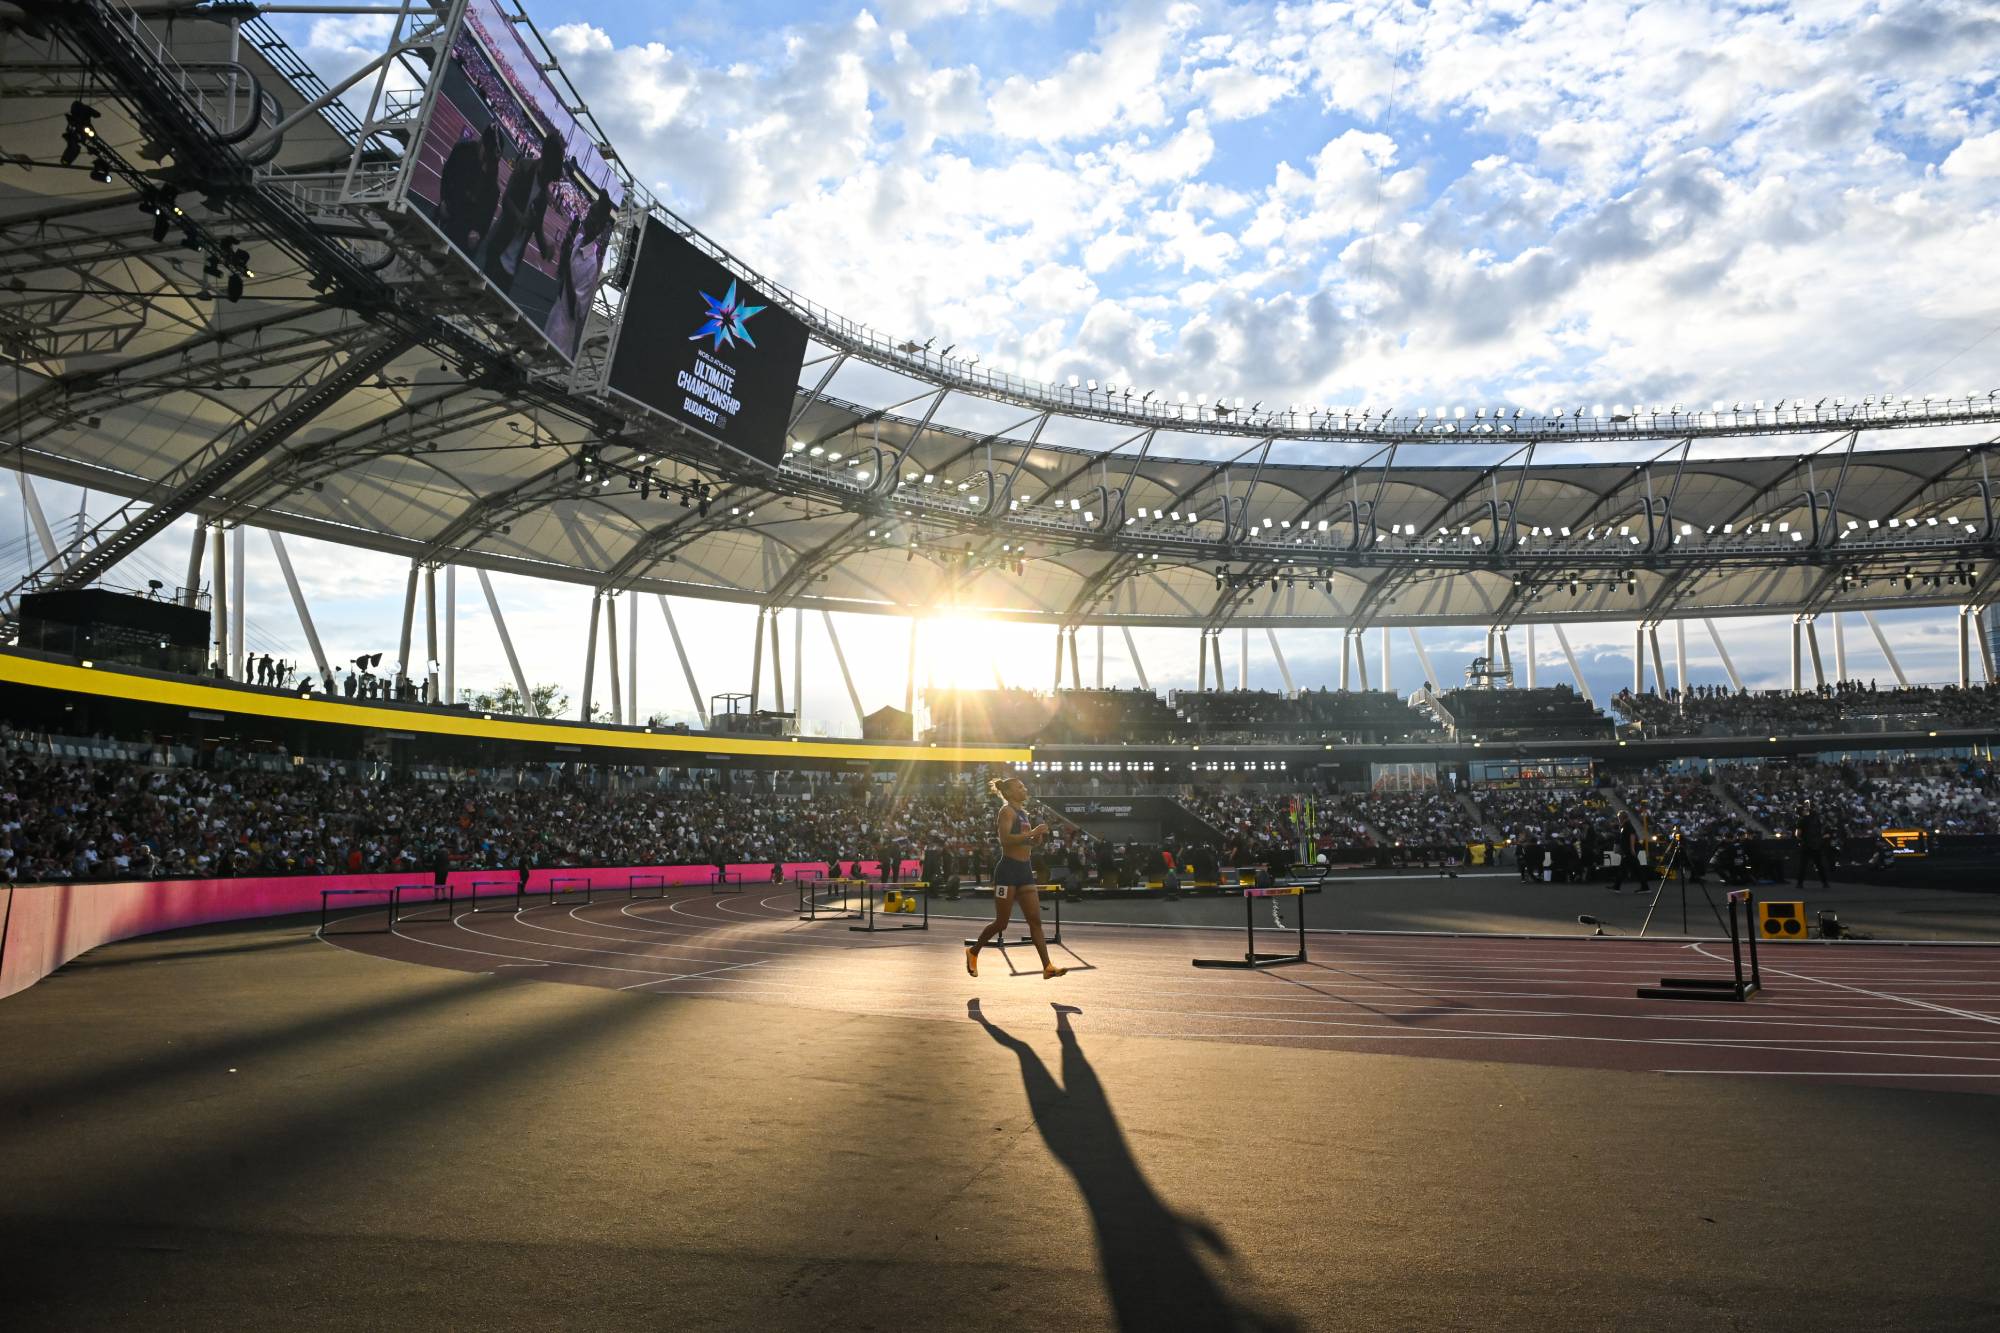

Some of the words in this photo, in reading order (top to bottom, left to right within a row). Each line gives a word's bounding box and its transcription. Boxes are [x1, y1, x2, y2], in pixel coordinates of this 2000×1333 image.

[694, 359, 735, 394] ULTIMATE
[677, 370, 741, 416] CHAMPIONSHIP
[683, 397, 718, 425] BUDAPEST
[998, 887, 1004, 896] 8
